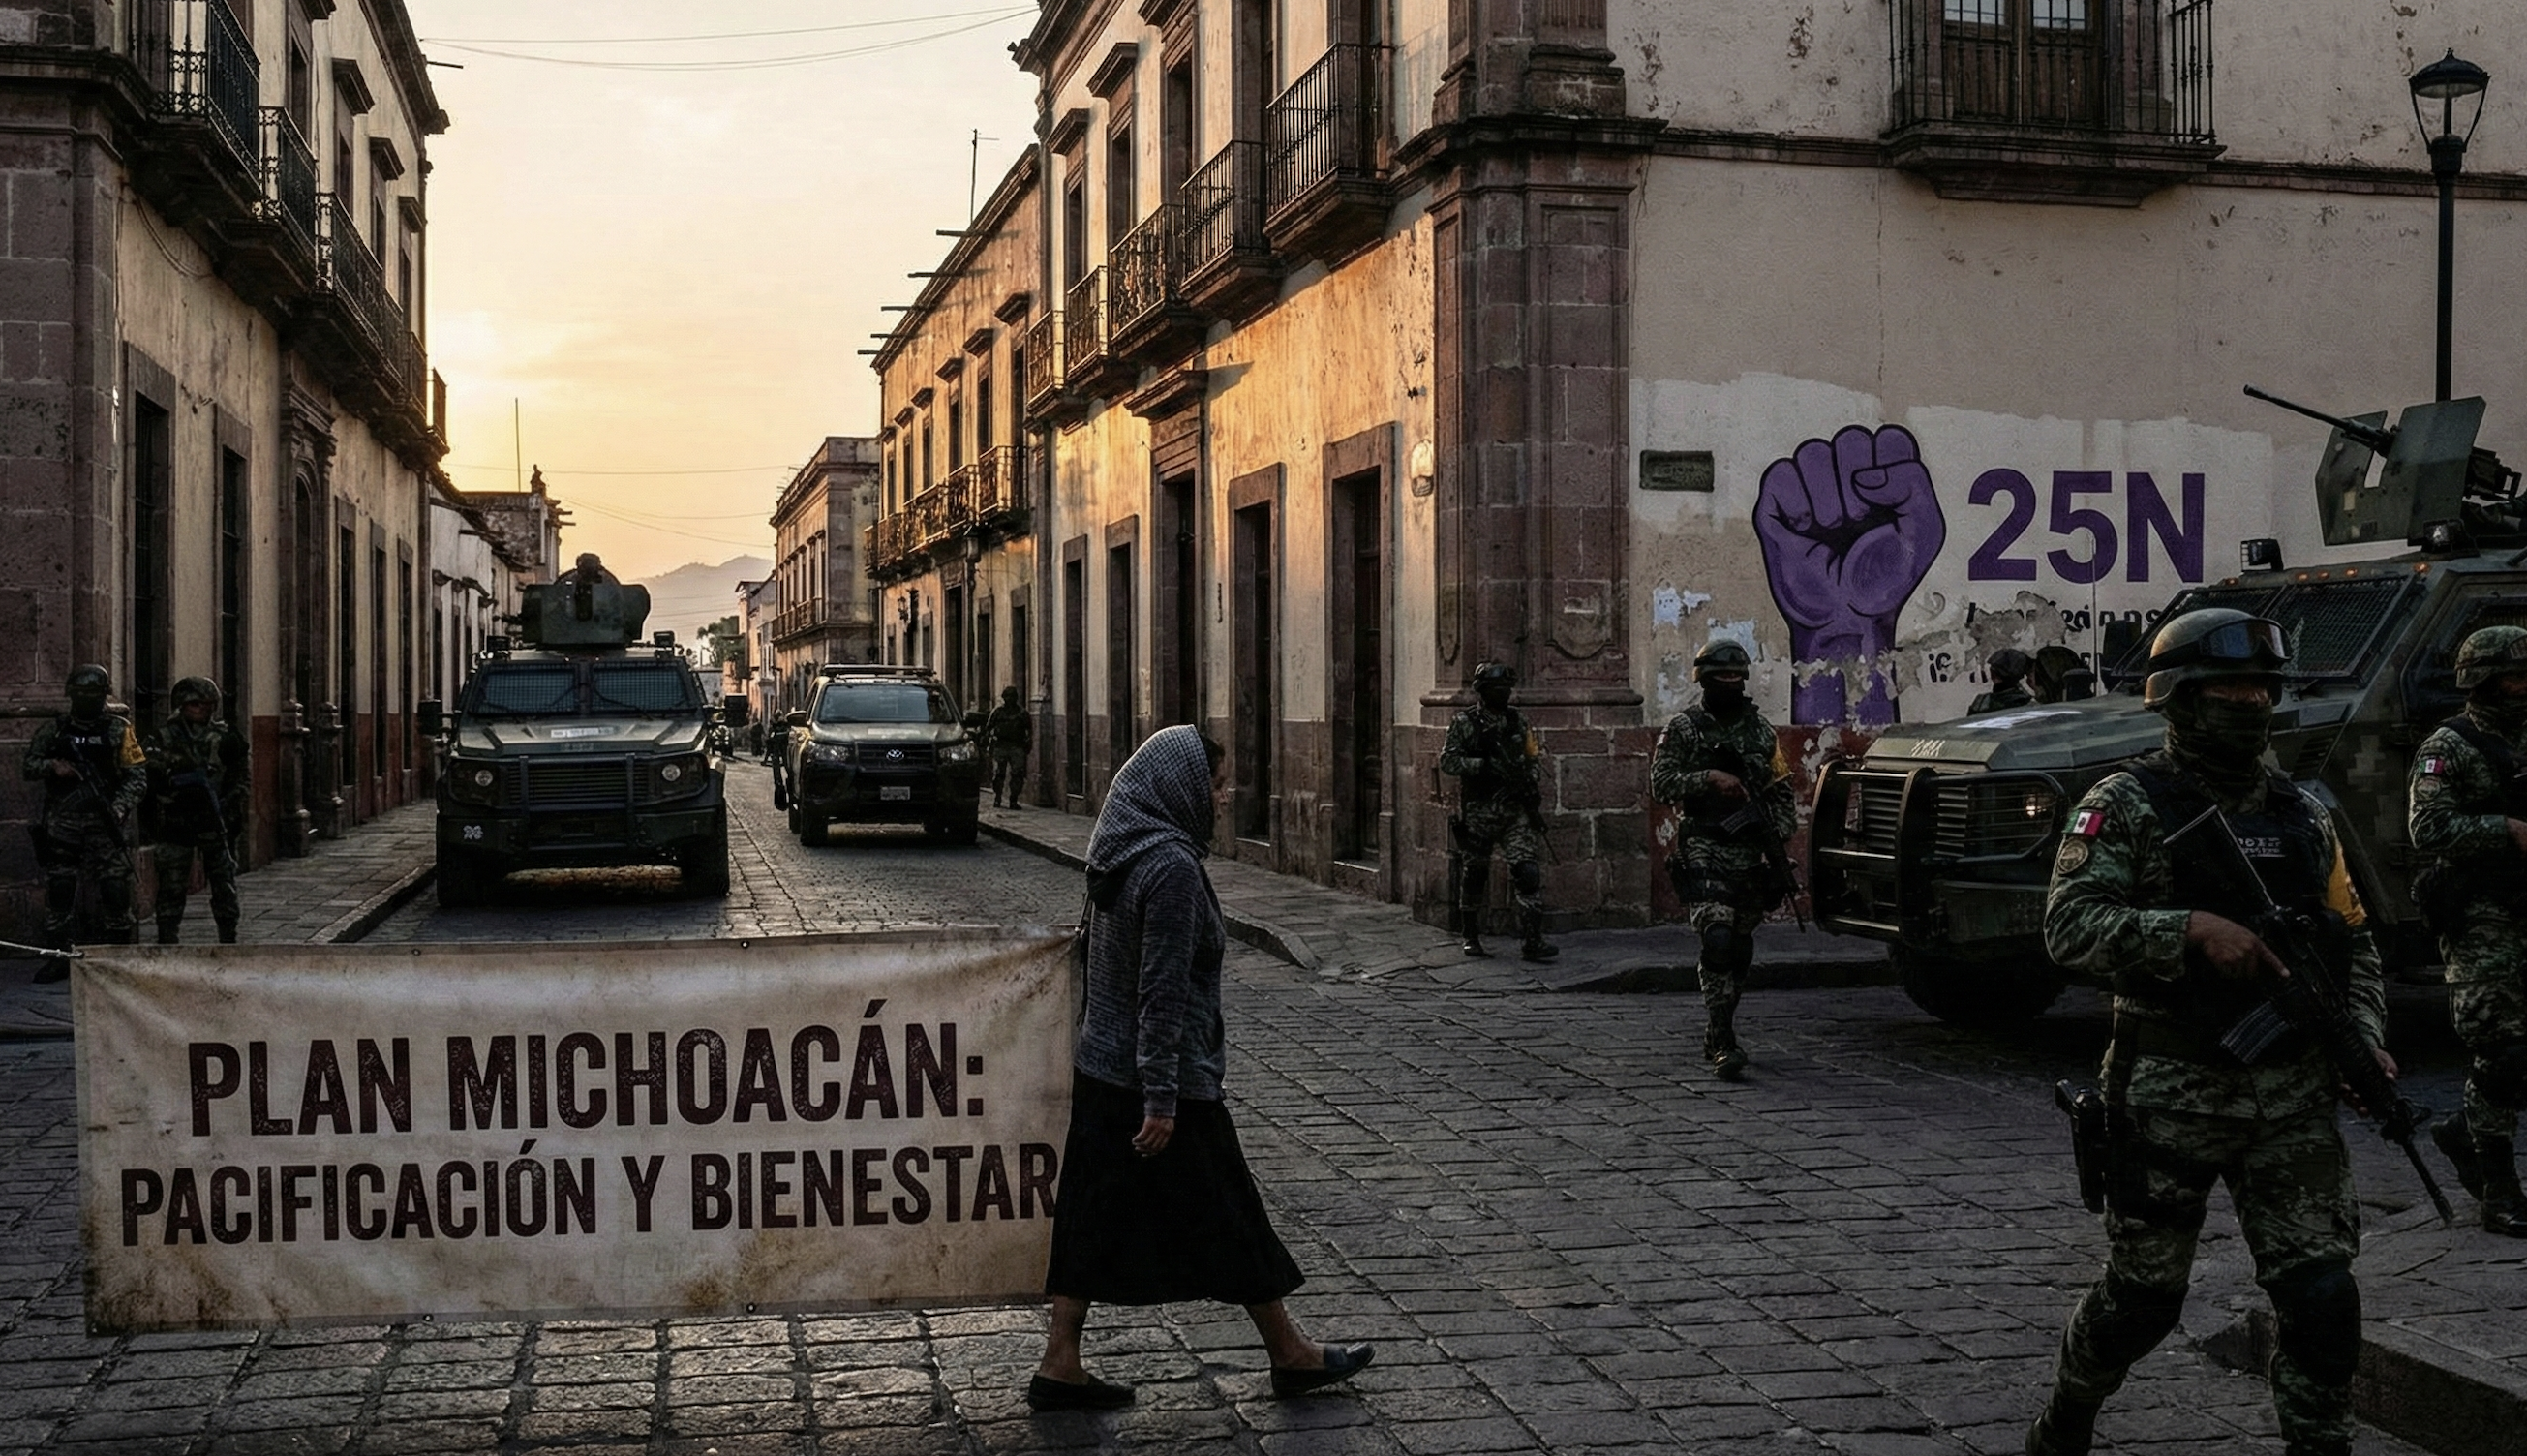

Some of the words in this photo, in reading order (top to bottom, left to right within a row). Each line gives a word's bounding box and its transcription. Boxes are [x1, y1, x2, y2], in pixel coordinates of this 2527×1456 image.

[1968, 468, 2205, 584] 25N
[189, 1038, 411, 1137] PLAN
[447, 998, 985, 1129] MICHOACÁN:
[121, 1138, 596, 1246] PACIFICACIÓN
[621, 1155, 666, 1232] Y
[692, 1143, 1057, 1230] BIENESTAR
